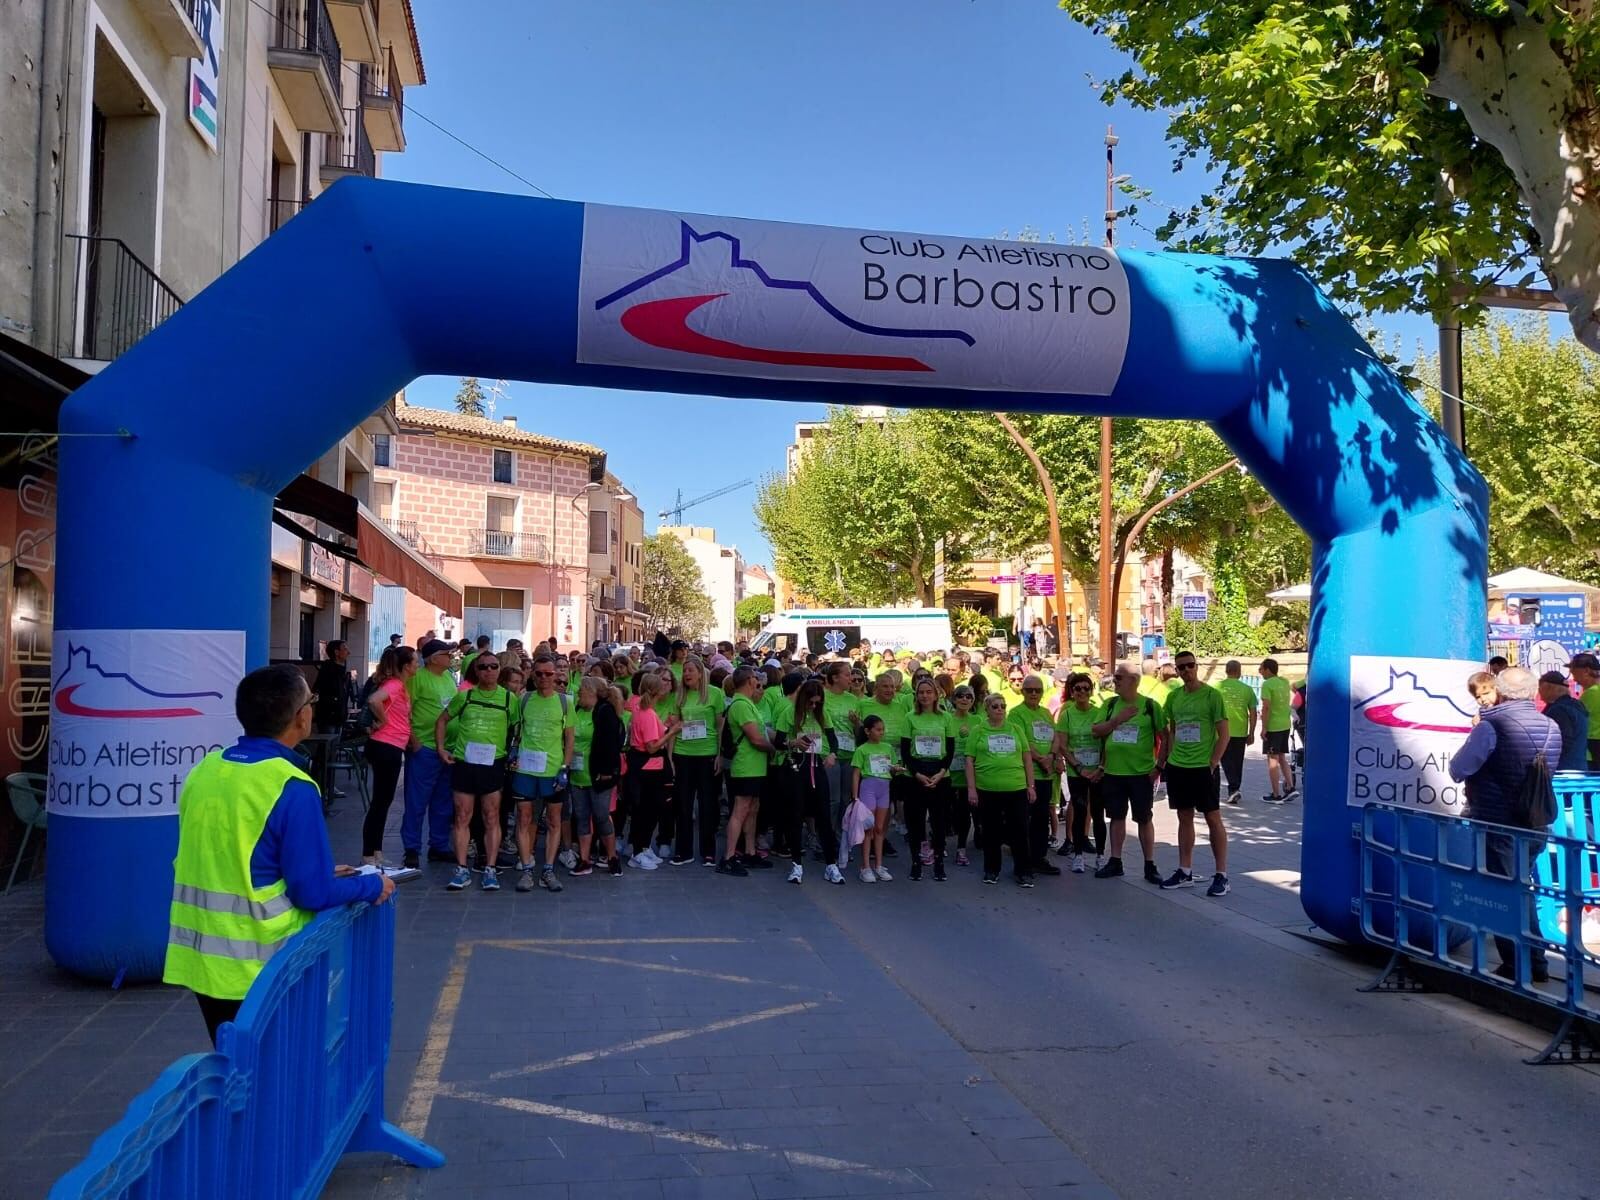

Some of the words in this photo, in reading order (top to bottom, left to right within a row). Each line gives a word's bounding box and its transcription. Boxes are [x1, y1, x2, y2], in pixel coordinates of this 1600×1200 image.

[859, 235, 945, 259] Club
[957, 244, 1110, 270] Atletismo
[864, 263, 1116, 315] Barbastro
[1355, 746, 1414, 770] Club
[50, 773, 182, 806] Barbast
[1355, 773, 1468, 805] Barba
